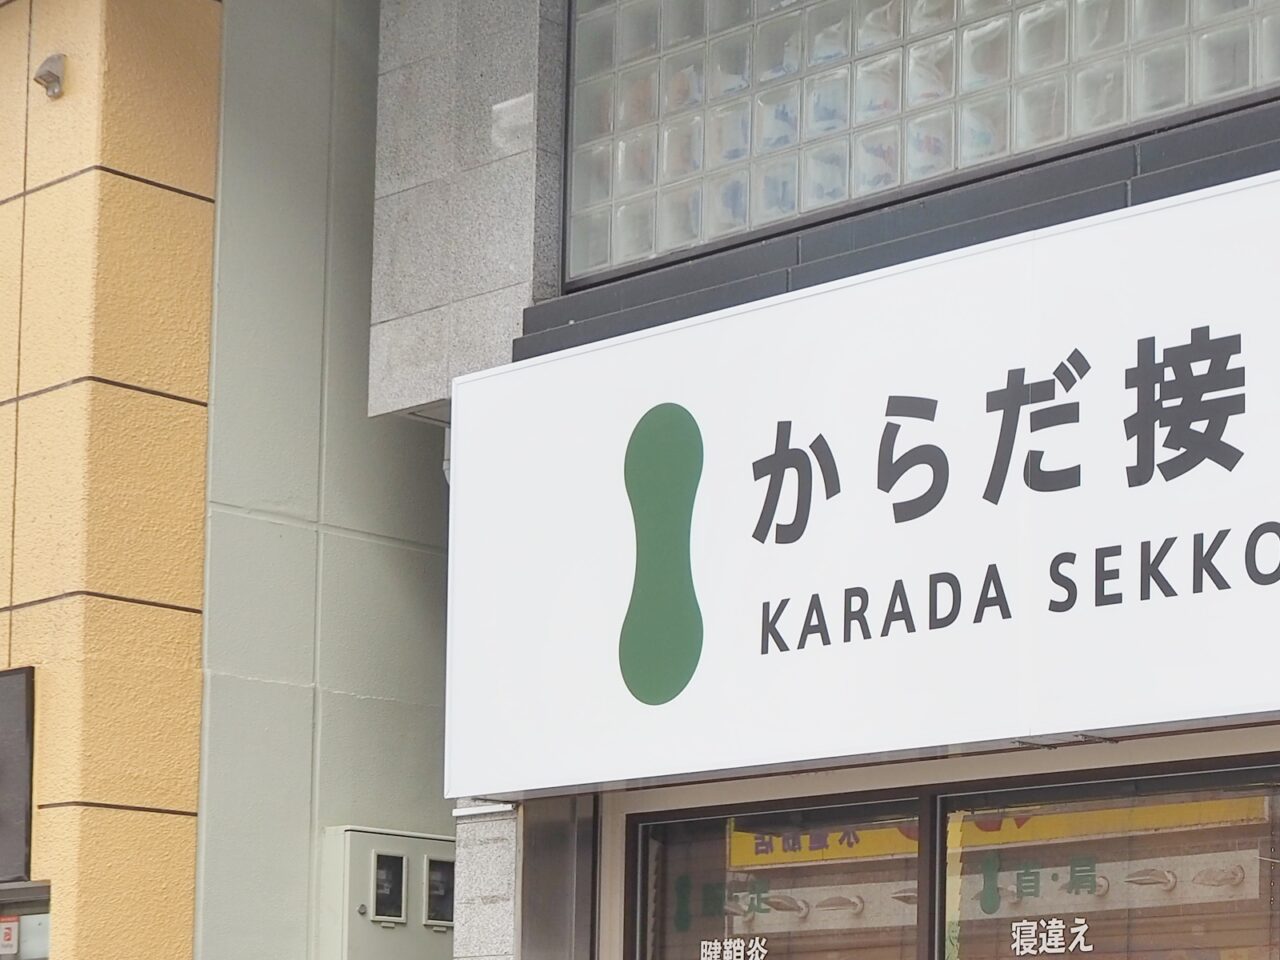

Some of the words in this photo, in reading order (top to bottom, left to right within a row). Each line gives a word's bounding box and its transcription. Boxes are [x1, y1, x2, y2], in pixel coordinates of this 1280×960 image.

[760, 564, 1012, 655] KARADA
[1015, 854, 1098, 898] 首・肩
[1010, 917, 1094, 956] 寝違え
